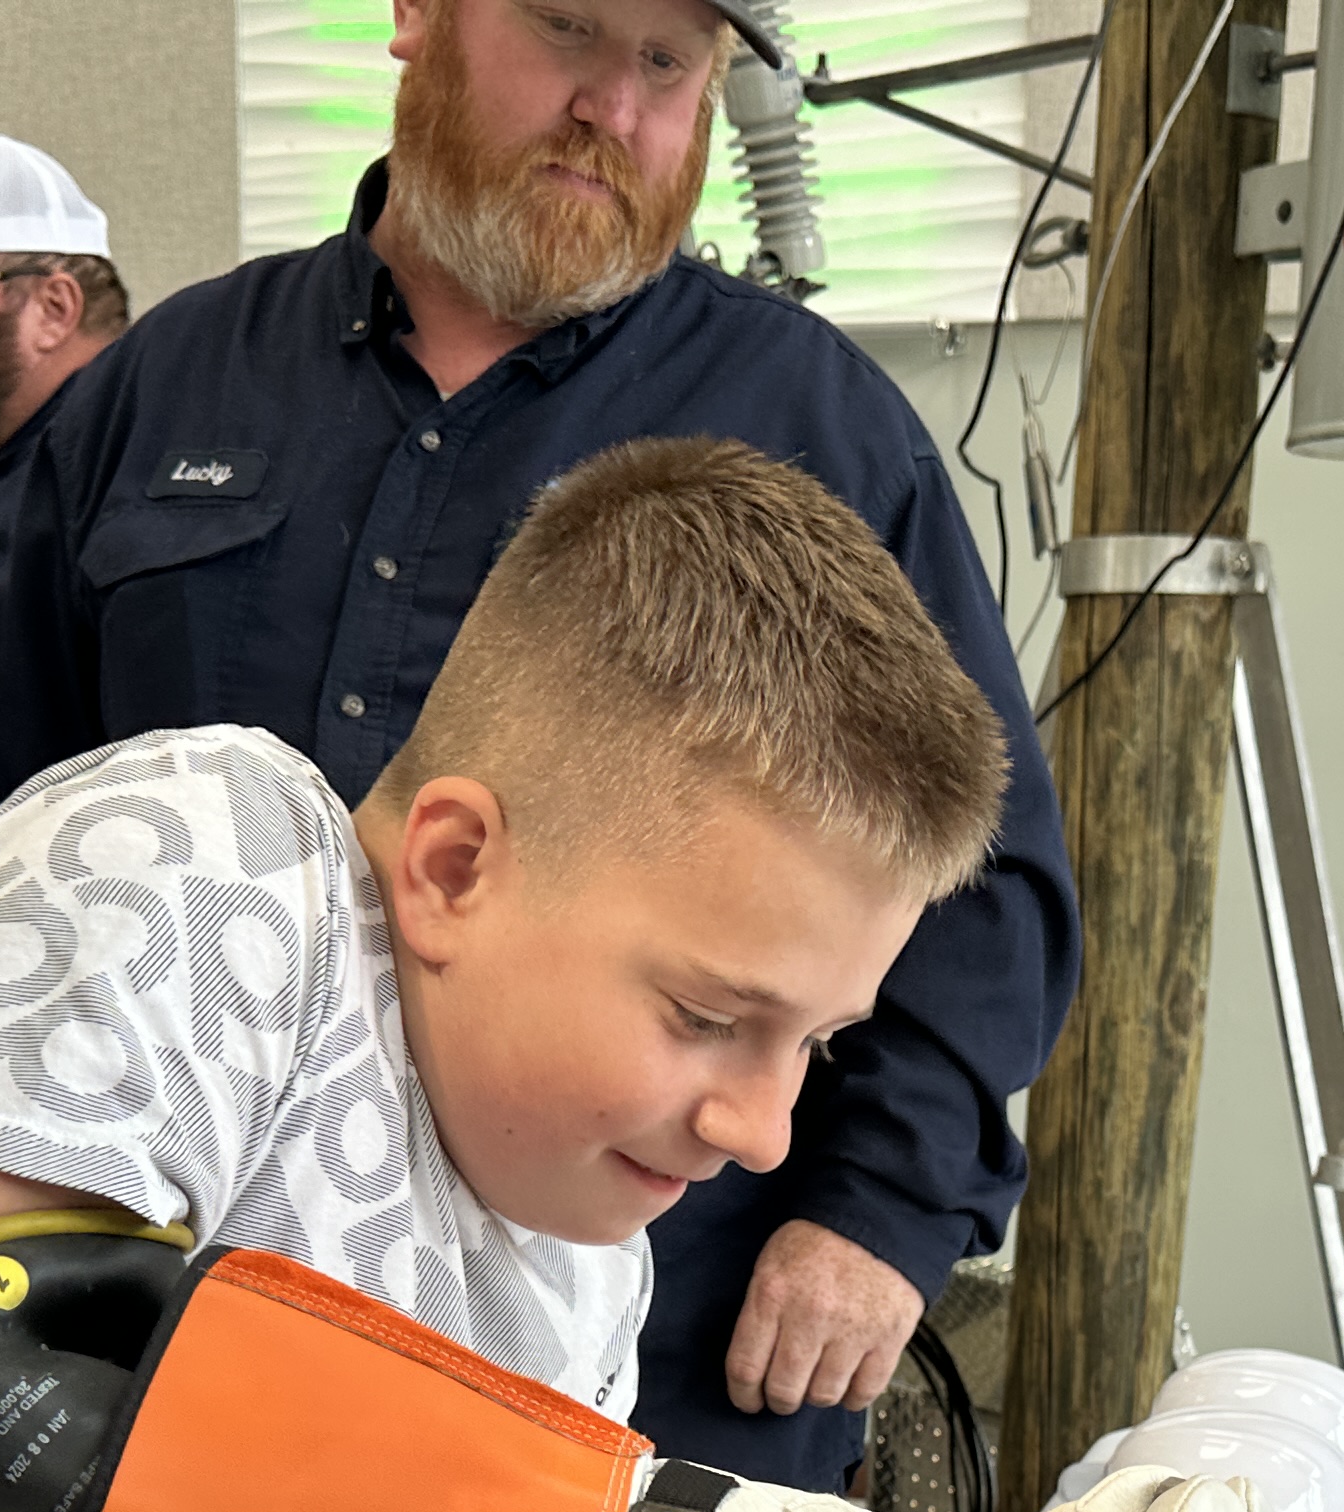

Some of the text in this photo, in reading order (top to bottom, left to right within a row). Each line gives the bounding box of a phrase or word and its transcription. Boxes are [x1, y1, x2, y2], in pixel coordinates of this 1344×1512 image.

[171, 460, 234, 486] Lucky
[20, 1376, 60, 1411] TESTED
[46, 1408, 72, 1433] JAN
[6, 1453, 31, 1483] 2024
